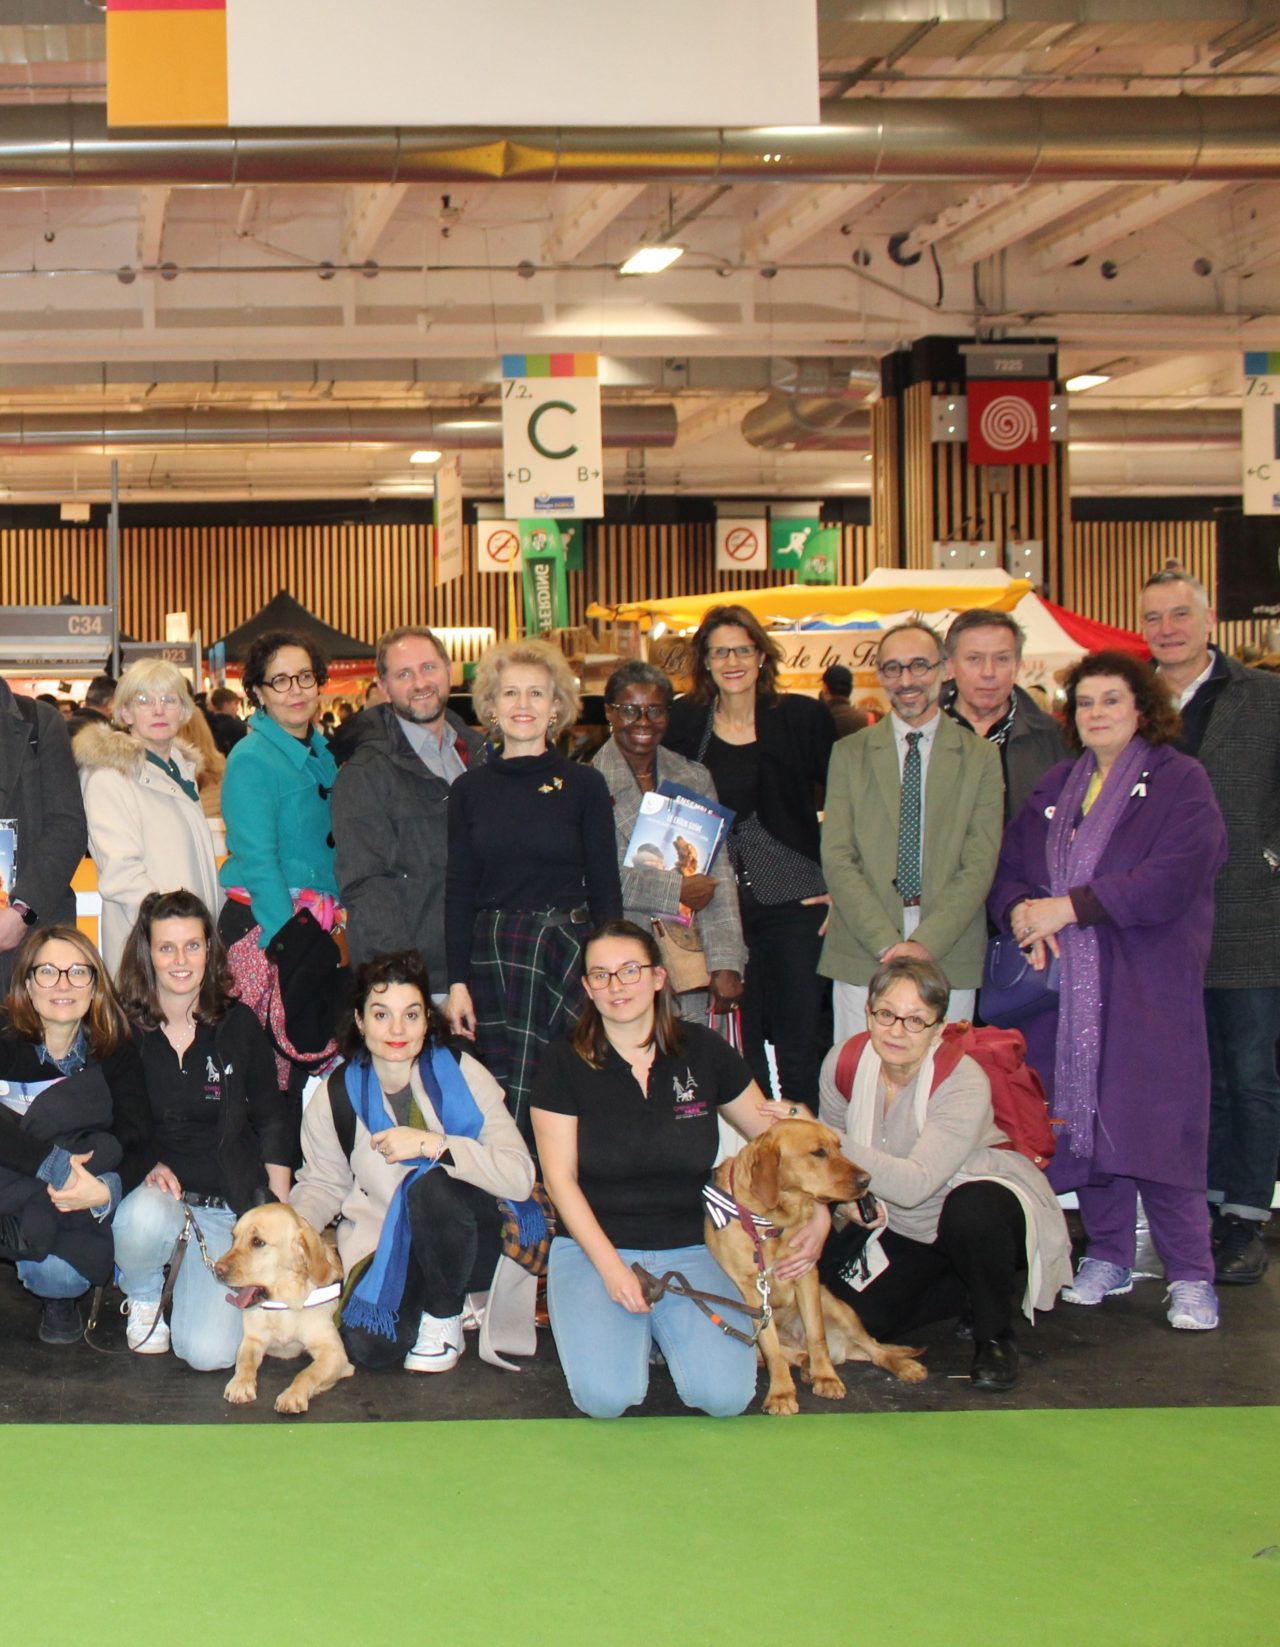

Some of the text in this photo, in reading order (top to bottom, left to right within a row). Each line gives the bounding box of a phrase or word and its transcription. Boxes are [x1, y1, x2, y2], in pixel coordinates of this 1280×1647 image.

[527, 400, 578, 459] C
[518, 468, 531, 483] D
[578, 467, 589, 482] B
[68, 616, 102, 634] C34
[786, 645, 810, 668] de
[819, 645, 840, 668] la
